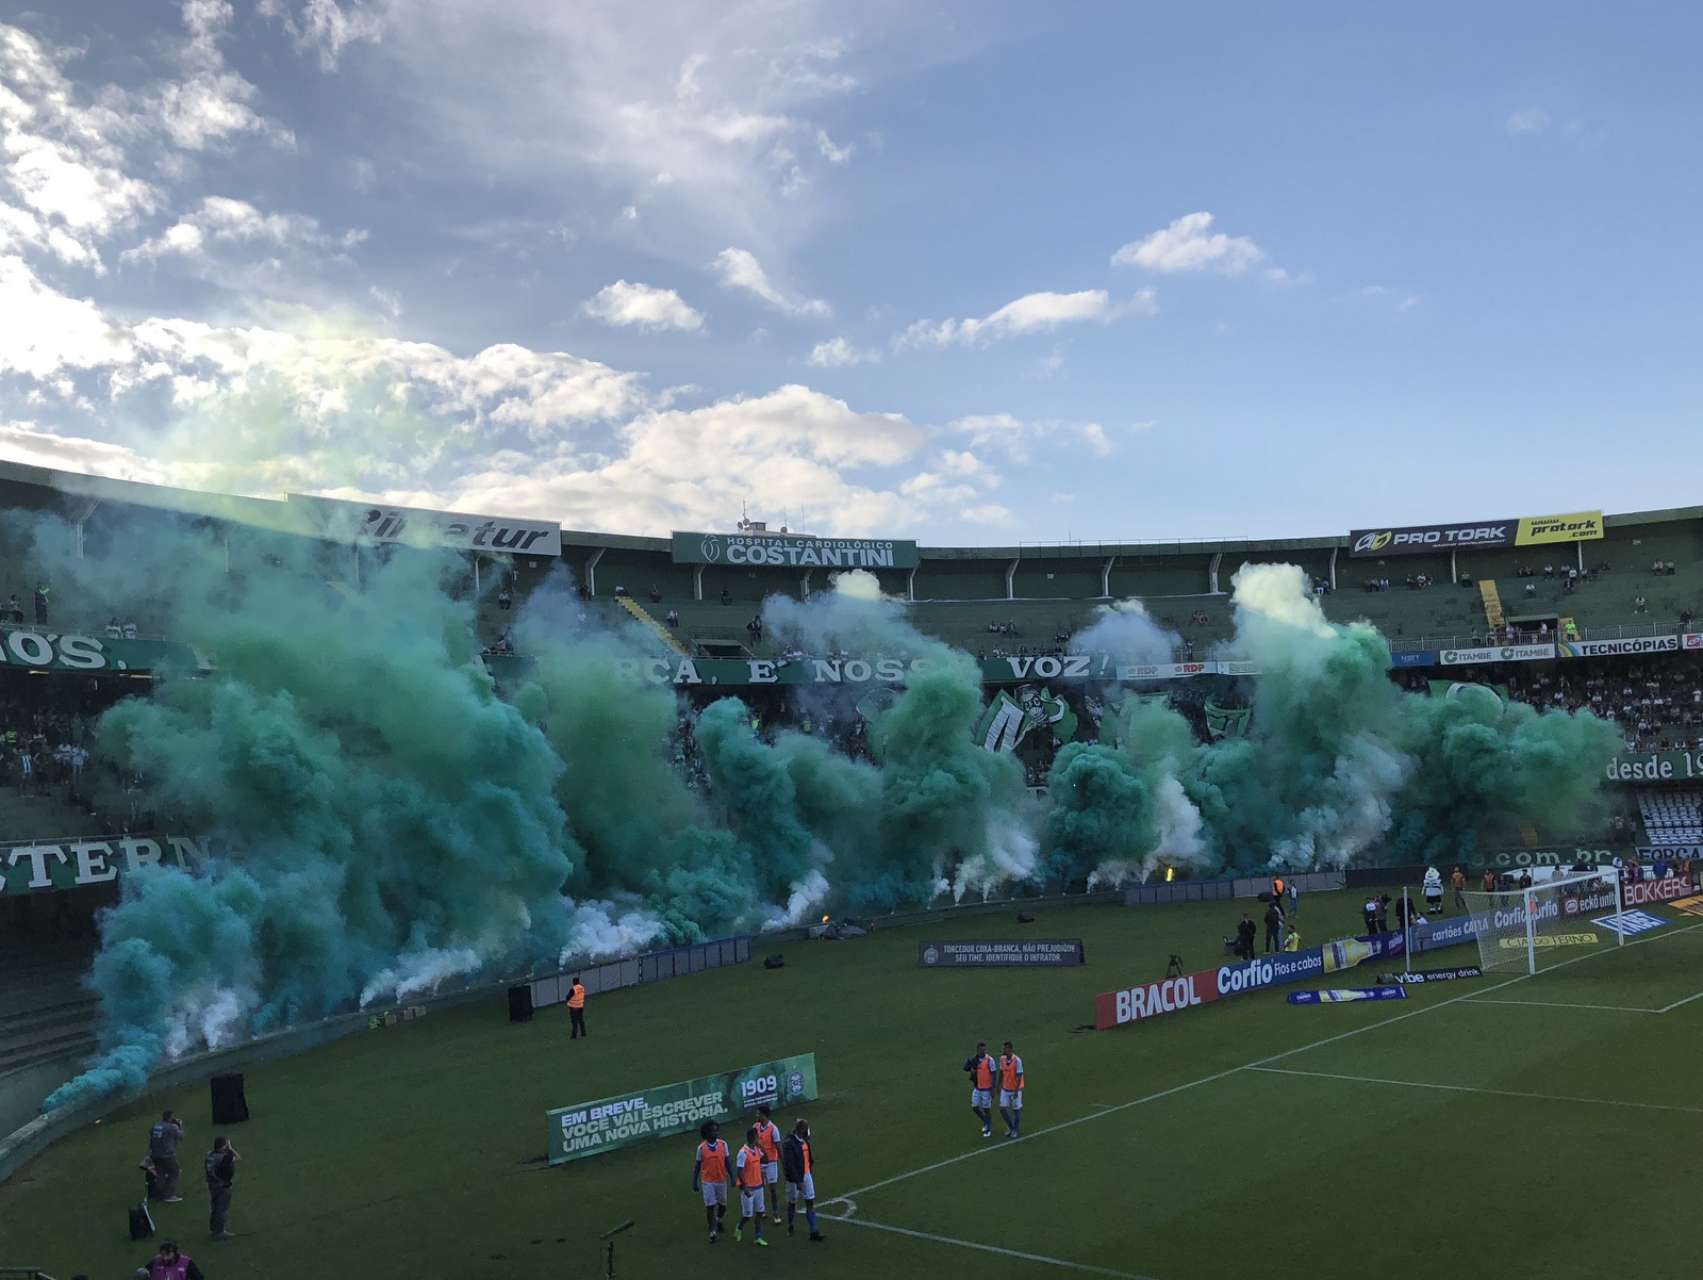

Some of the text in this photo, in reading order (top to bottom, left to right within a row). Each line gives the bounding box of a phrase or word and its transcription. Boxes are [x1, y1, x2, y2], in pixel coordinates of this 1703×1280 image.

[1394, 530, 1441, 545] PRO
[1445, 526, 1506, 542] TORK
[1531, 520, 1597, 536] protork
[727, 536, 893, 549] HOSPITAL CARDIOLÓGICO
[727, 545, 894, 566] COSTANTINI
[1582, 638, 1677, 656] TECNICÓPIAS
[1183, 664, 1205, 673] RDP
[1606, 755, 1673, 780] desde
[1624, 878, 1681, 907] BOKKER
[1432, 917, 1489, 941] cartões CAIXA
[1217, 960, 1273, 995] Corfio
[1290, 962, 1296, 972] e
[1297, 955, 1322, 971] cabos
[1394, 968, 1480, 984] vibe energy drink
[1116, 976, 1201, 1024] BRACOL
[741, 1075, 777, 1097] 1909
[561, 1097, 649, 1128] EM BREVE,
[613, 1111, 639, 1128] VAI
[642, 1091, 723, 1120] ESCREVER
[562, 1134, 603, 1153] UMA
[605, 1122, 651, 1142] NOVA
